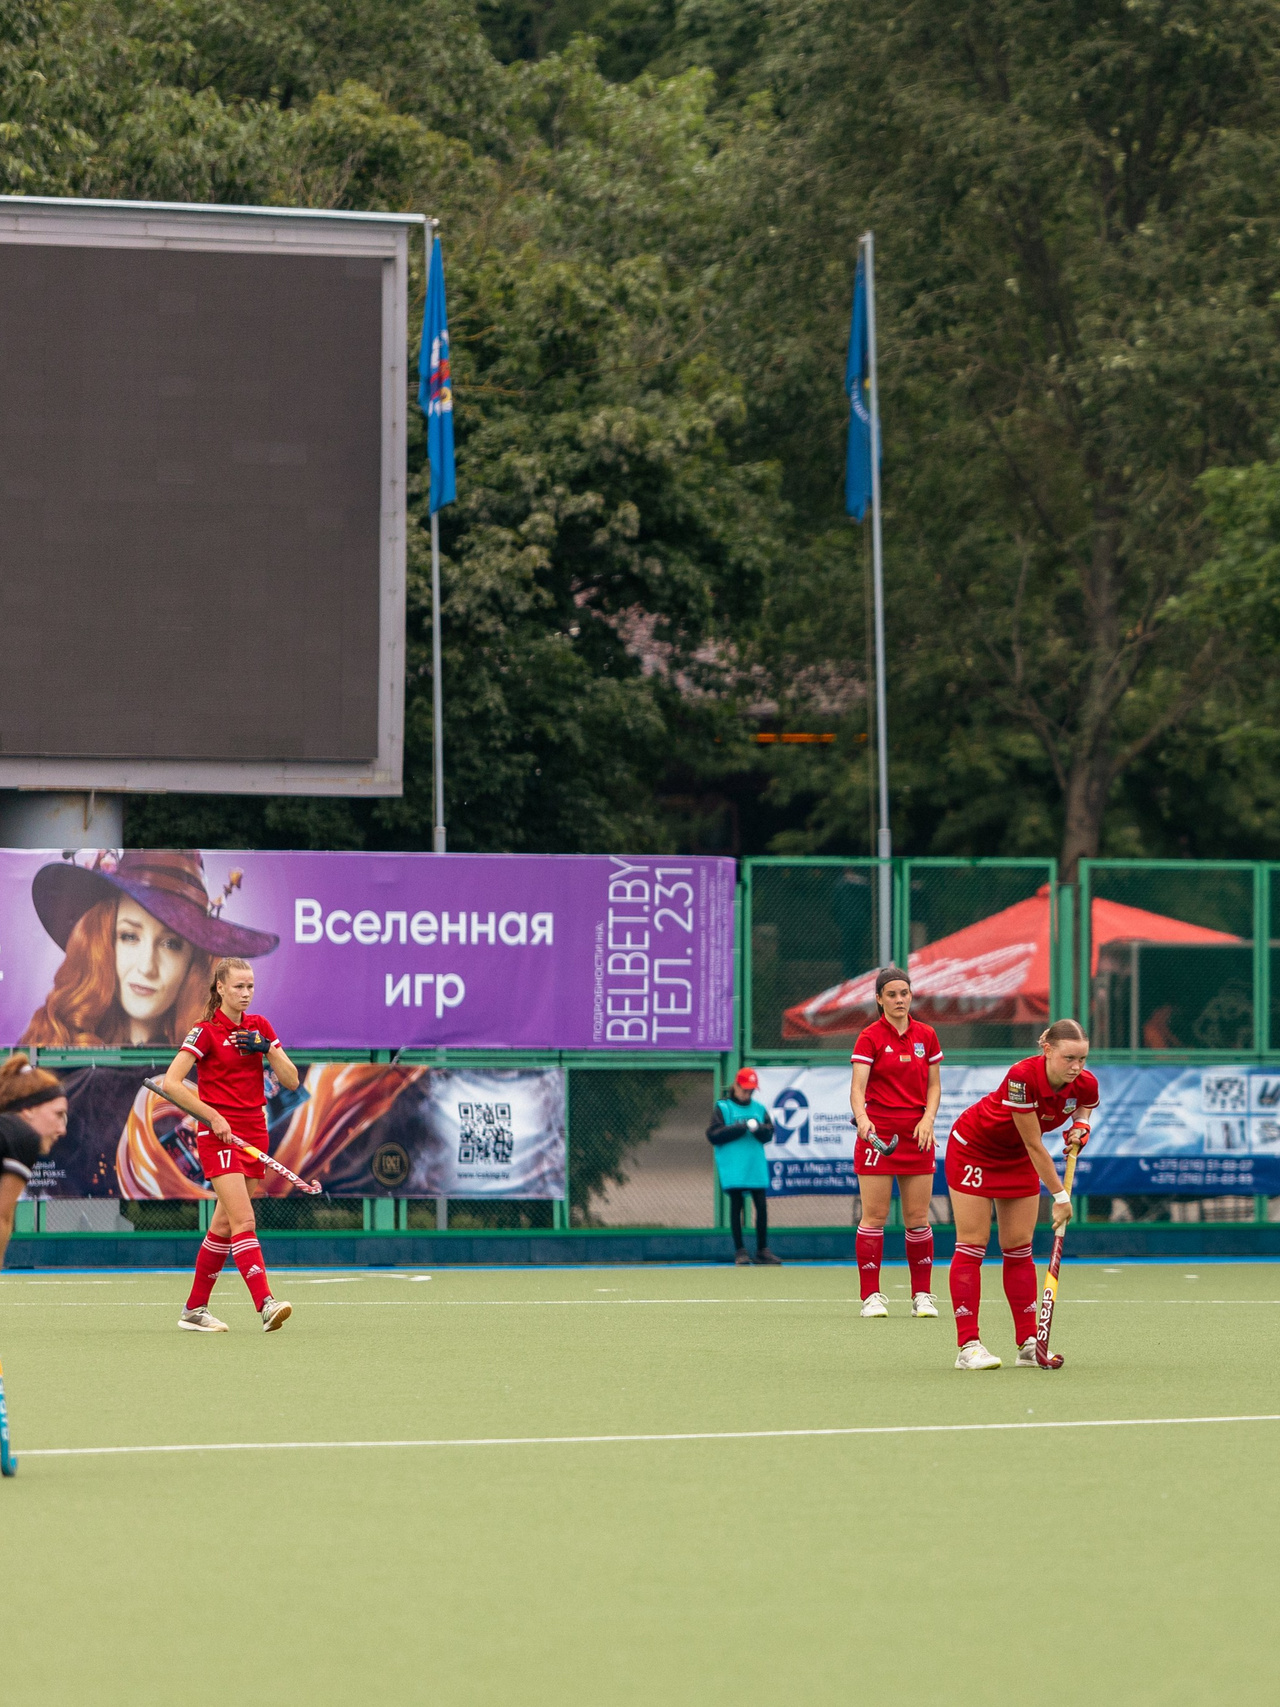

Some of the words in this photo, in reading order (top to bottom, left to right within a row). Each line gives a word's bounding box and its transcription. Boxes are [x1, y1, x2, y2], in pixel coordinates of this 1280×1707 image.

[295, 898, 553, 946] Вселенная
[653, 867, 694, 933] 231
[606, 855, 650, 1042] BELBET.BY
[385, 973, 466, 1019] игр
[652, 946, 693, 1043] ТЕЛ.
[217, 1149, 232, 1169] 17
[864, 1148, 880, 1167] 27
[960, 1164, 983, 1188] 23
[1036, 1287, 1054, 1341] Grays
